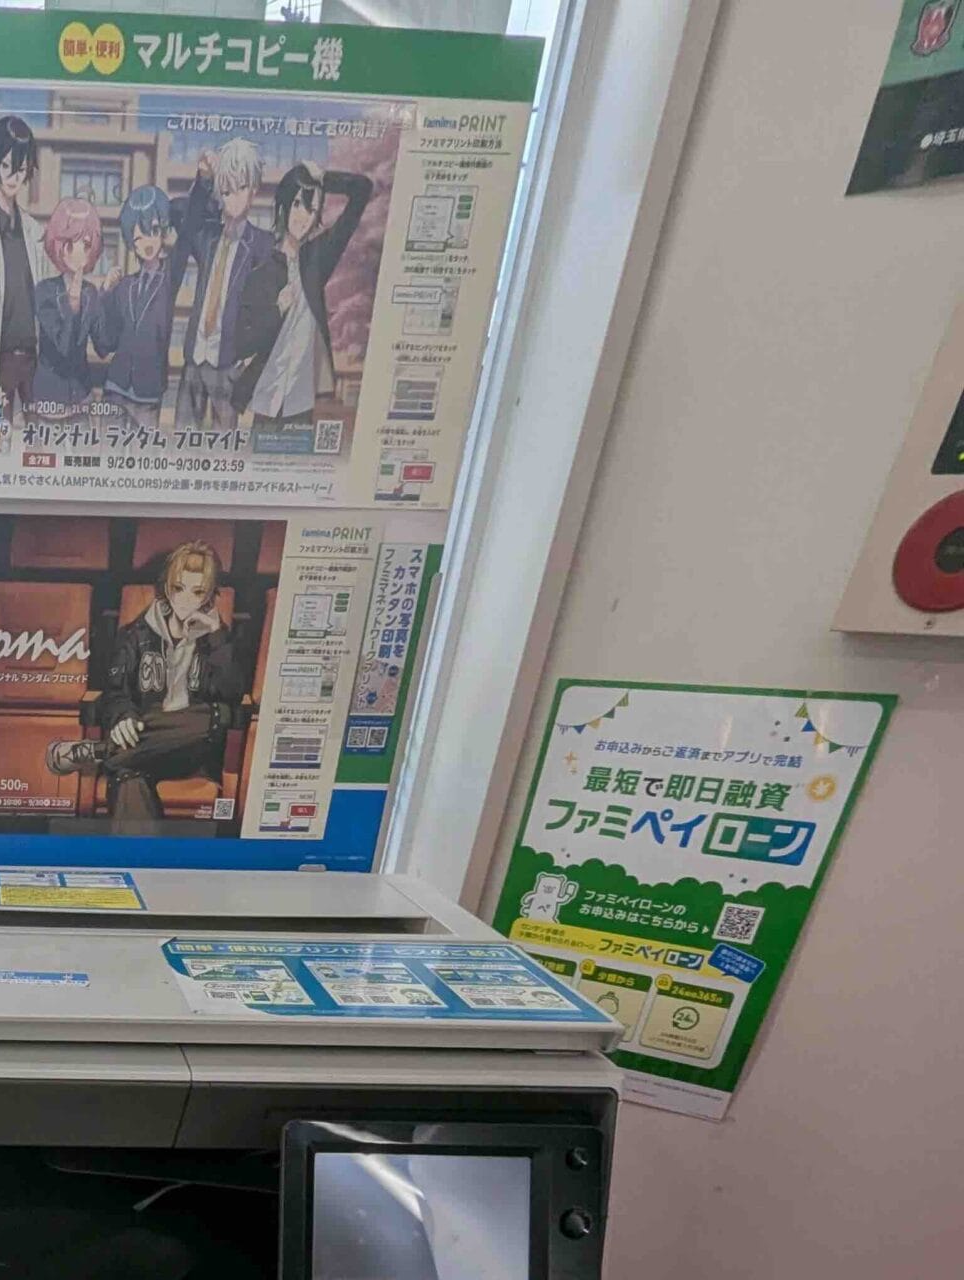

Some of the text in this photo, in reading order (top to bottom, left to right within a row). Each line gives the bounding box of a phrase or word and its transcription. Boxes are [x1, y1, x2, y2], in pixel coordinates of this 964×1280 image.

[63, 39, 121, 59] 簡単・便利
[133, 32, 344, 80] マルチコピー機
[458, 115, 507, 132] PRINT
[23, 424, 100, 447] オリジナル
[106, 426, 166, 448] ランダム
[332, 526, 372, 540] PRINT
[378, 566, 406, 659] カンタン印刷
[393, 549, 423, 658] スマホの写真を
[21, 674, 50, 682] ランダム
[594, 739, 803, 769] お申込みからご返済までアプリで完結
[583, 766, 793, 811] 最短で即日融資
[544, 799, 810, 858] ファミペイローン
[585, 889, 687, 915] ファミペイローンの
[579, 903, 699, 933] お申込みはこちらから
[599, 938, 704, 968] ファミペイローン
